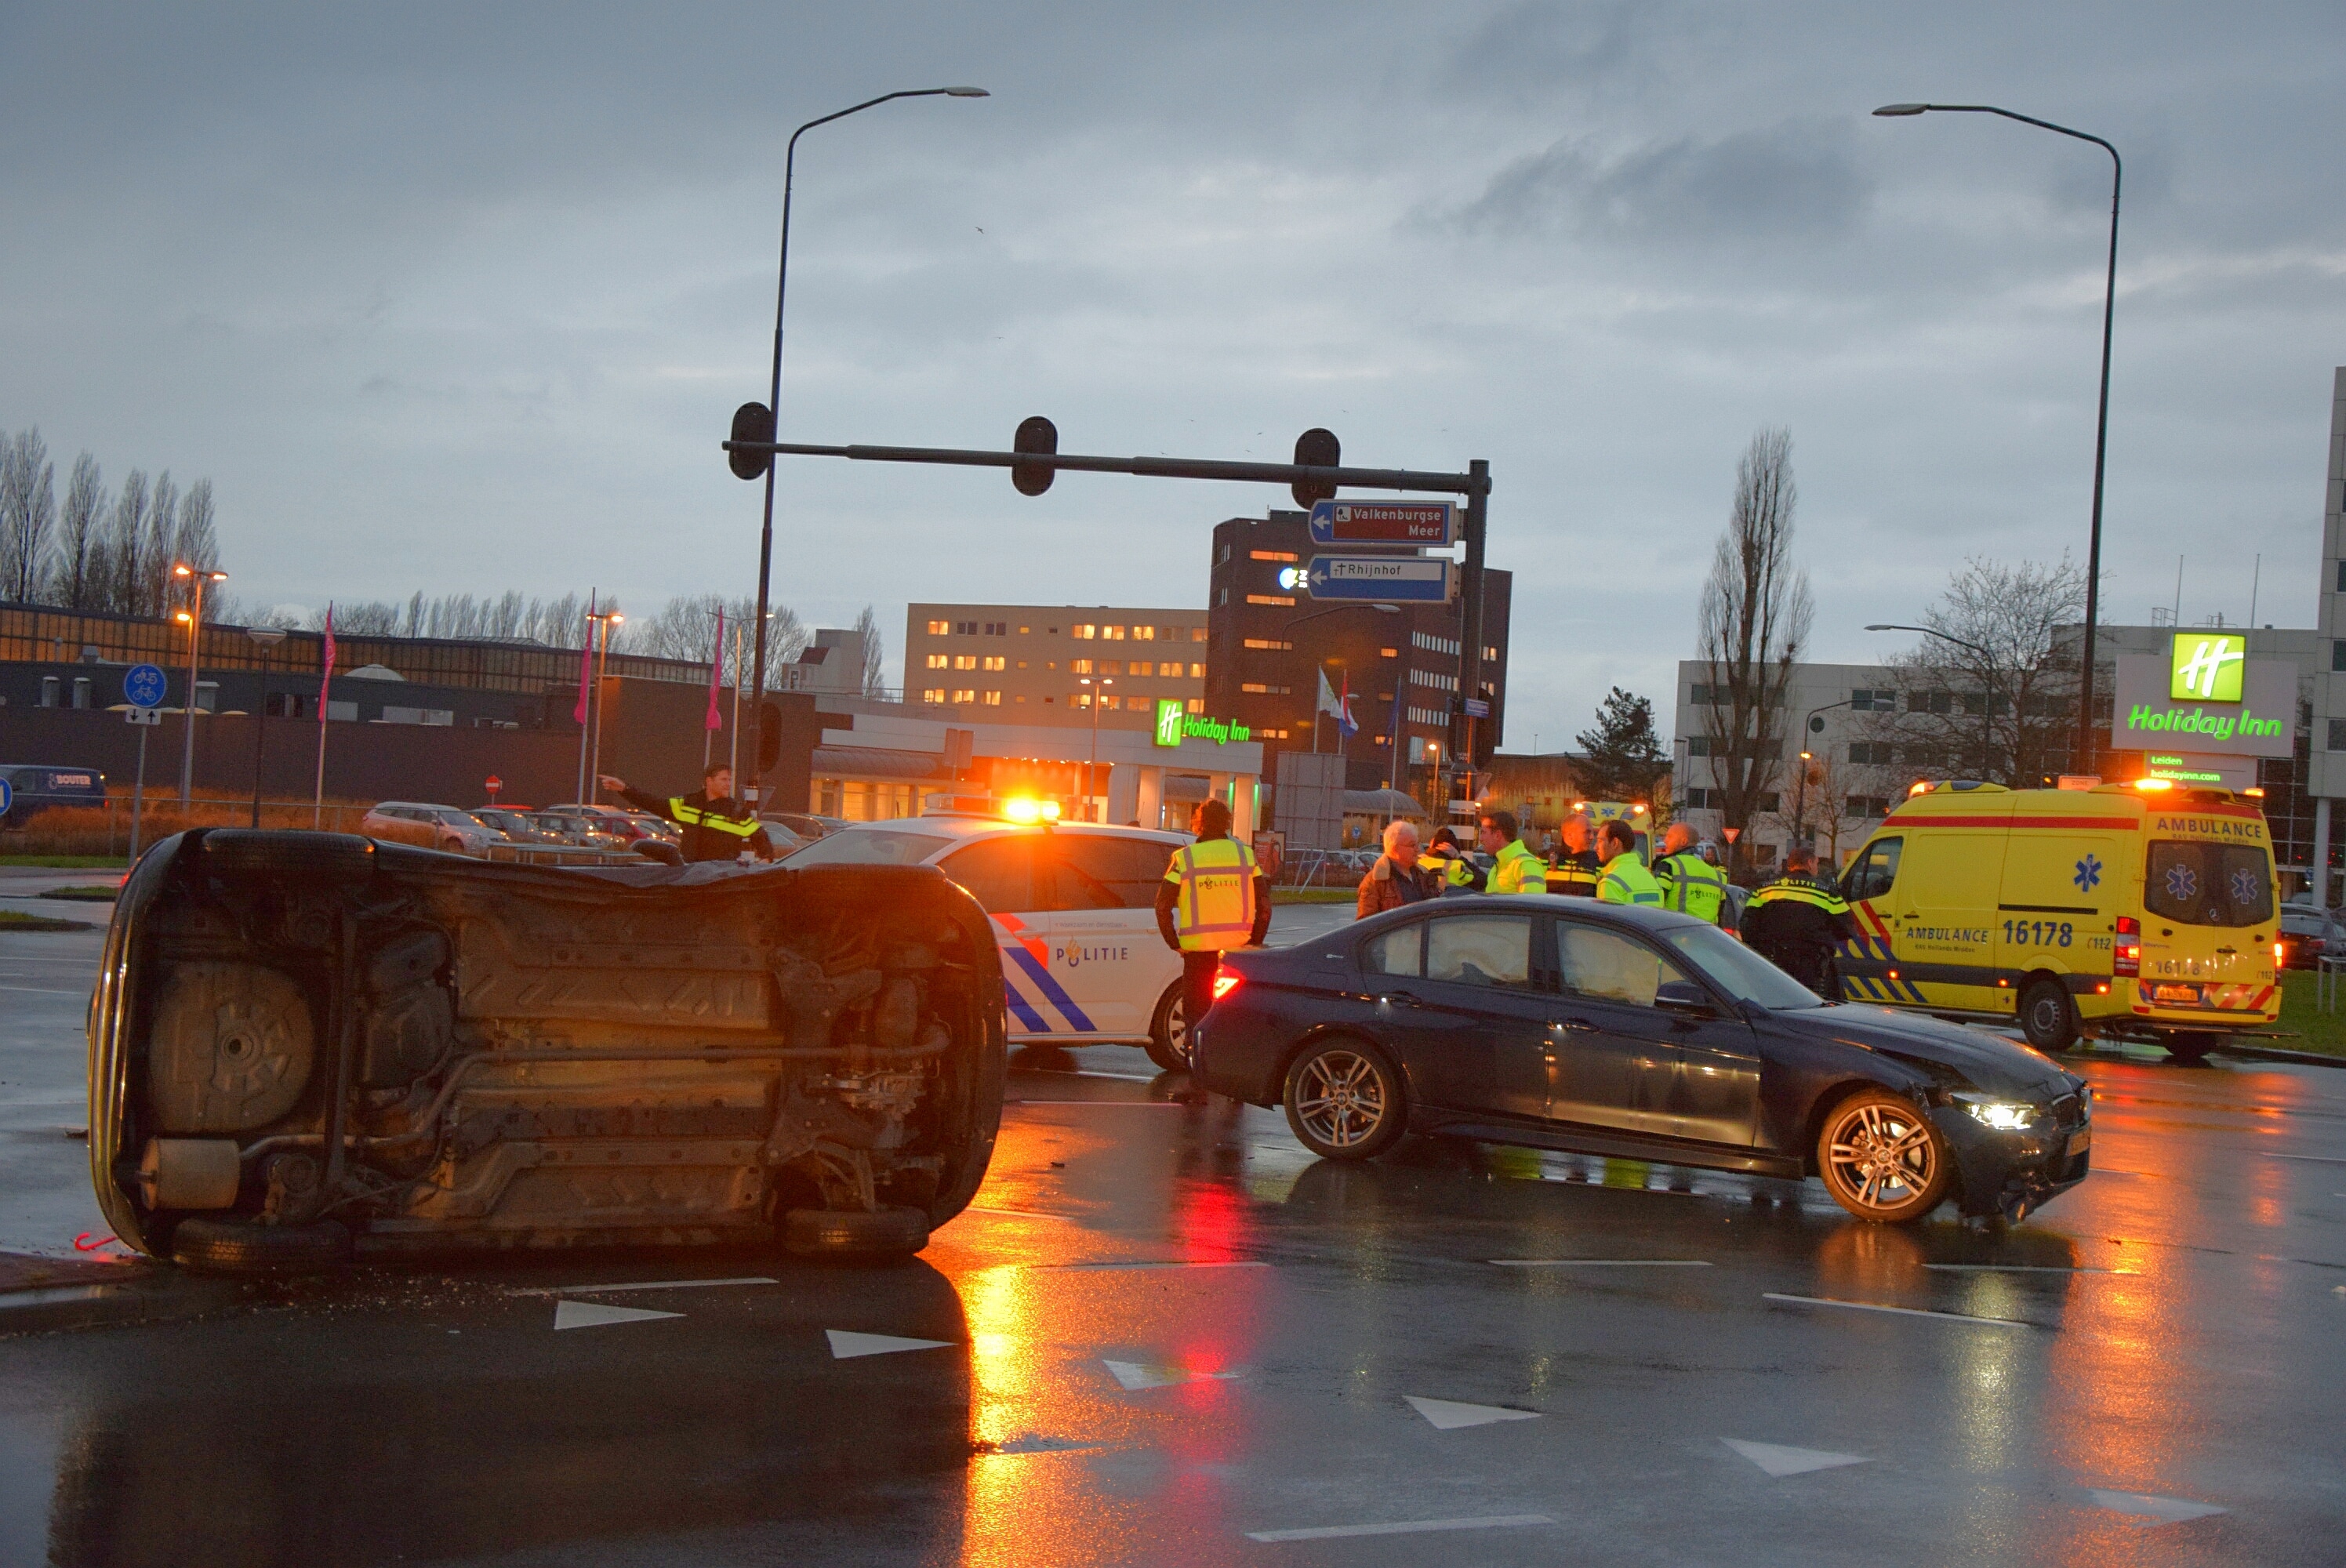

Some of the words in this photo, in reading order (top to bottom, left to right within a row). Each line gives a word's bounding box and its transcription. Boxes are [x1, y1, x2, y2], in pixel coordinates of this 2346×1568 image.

[1353, 508, 1441, 524] Valkenburgse
[1408, 524, 1440, 536] Meer
[1349, 564, 1401, 577] Rhijnhof
[1183, 713, 1229, 745] Holiday
[1230, 718, 1251, 742] Inn
[2127, 704, 2235, 741] Holiday
[2238, 709, 2282, 737] Inn
[2151, 756, 2183, 765] Leiden
[56, 775, 91, 785] BOUTER
[2151, 769, 2221, 782] holidayinn.com
[2156, 818, 2262, 839] AMBULANCE
[1906, 927, 1988, 942] AMBULANCE
[2003, 920, 2072, 947] 16178
[1055, 943, 1128, 967] POLITIE
